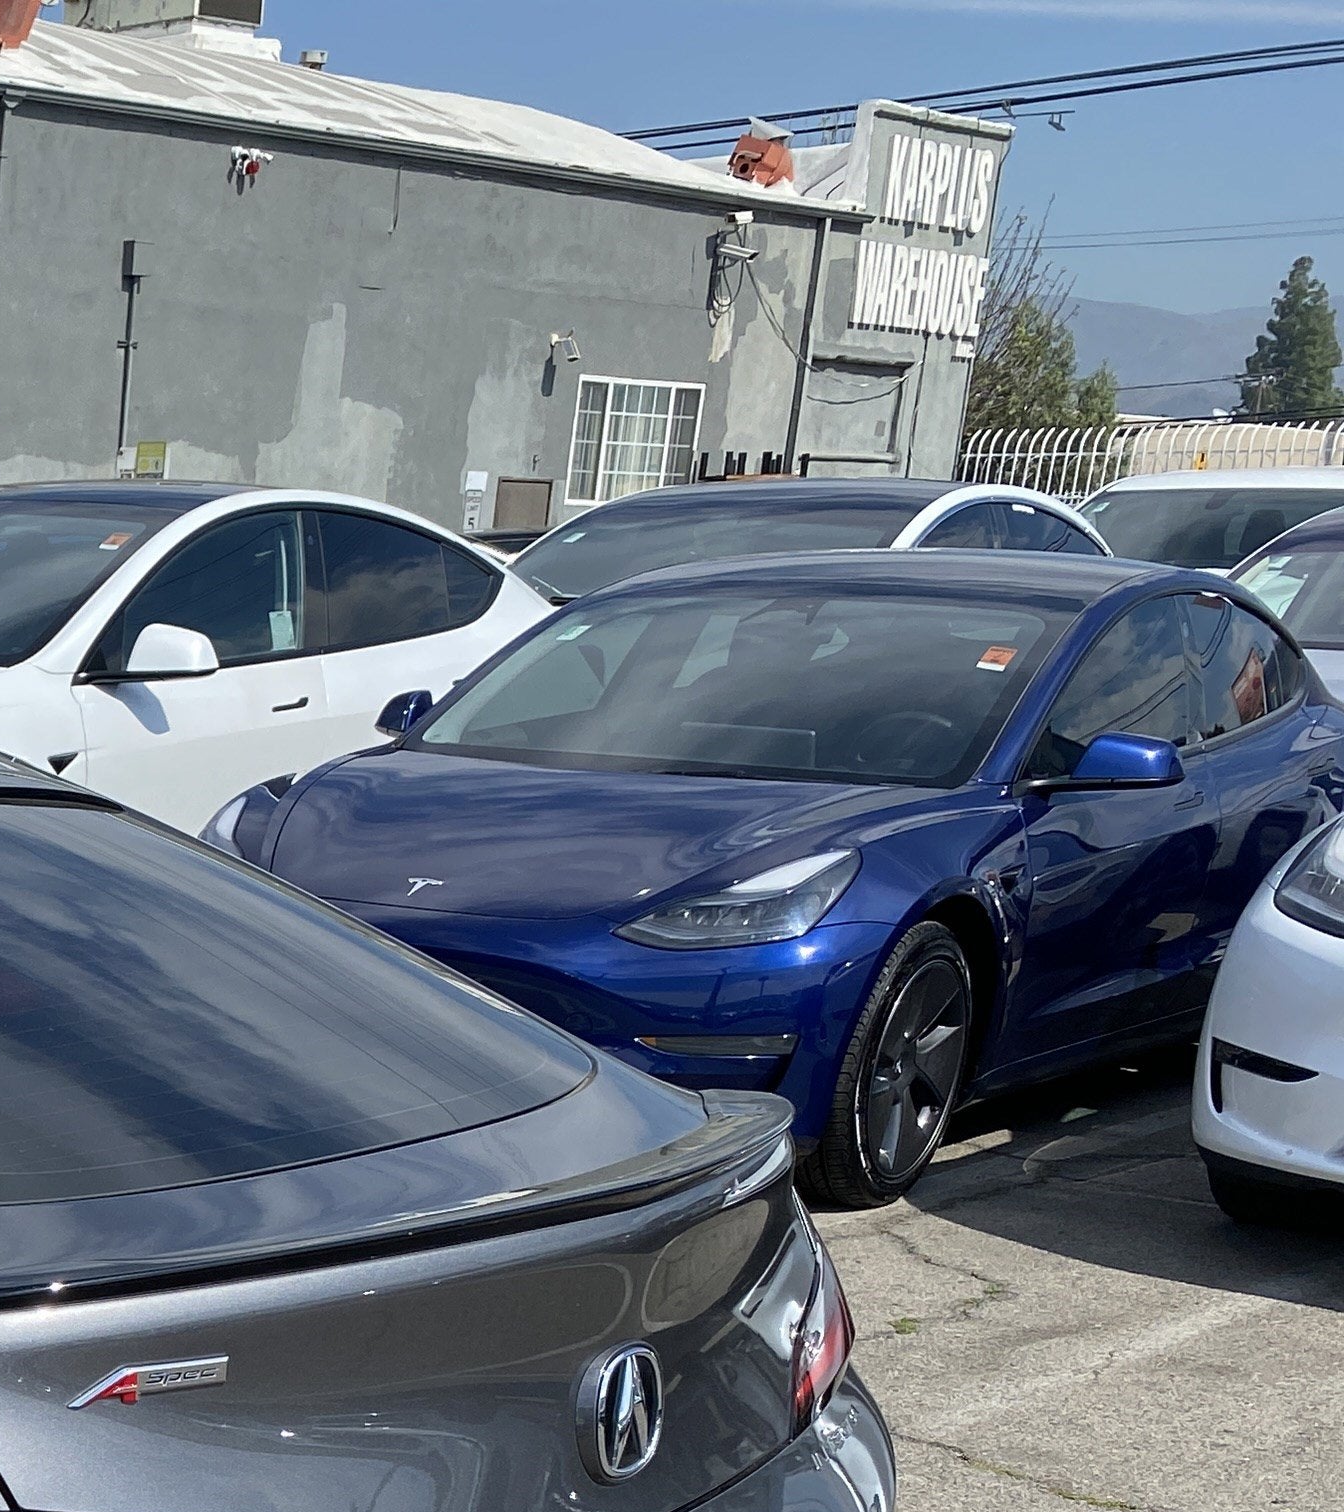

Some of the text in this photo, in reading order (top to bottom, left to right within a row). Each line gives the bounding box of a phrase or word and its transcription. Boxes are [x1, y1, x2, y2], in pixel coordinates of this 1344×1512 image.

[885, 133, 994, 233] KARPLUS
[852, 239, 989, 337] WAREHOUSE
[467, 516, 475, 530] 5
